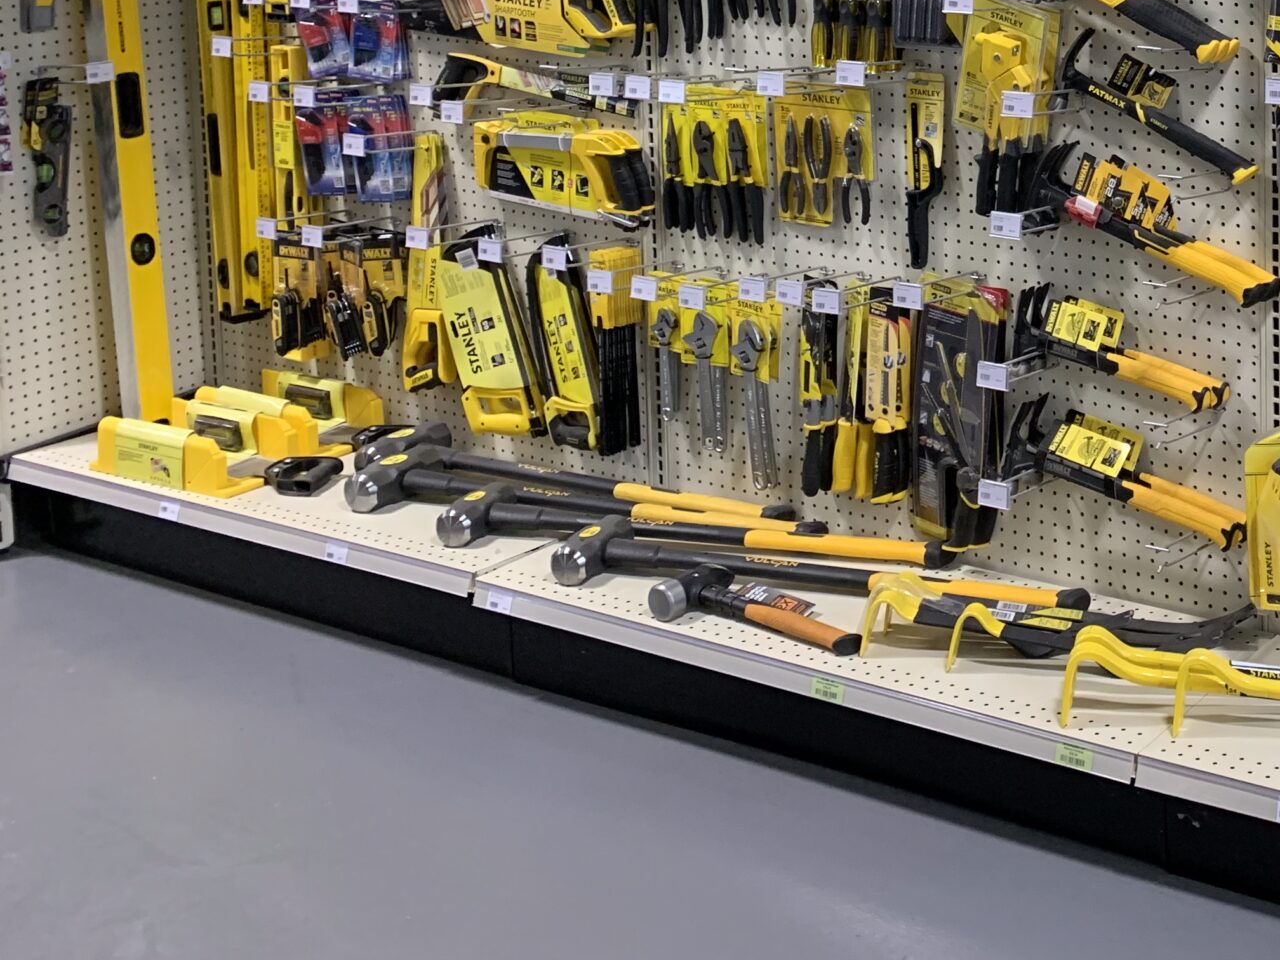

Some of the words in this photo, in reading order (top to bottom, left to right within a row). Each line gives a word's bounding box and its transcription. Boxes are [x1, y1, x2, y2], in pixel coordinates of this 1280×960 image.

[990, 11, 1023, 28] STANLEY
[802, 94, 841, 104] STANLEY
[910, 89, 940, 97] STANLEY
[1087, 85, 1127, 109] FATMAX
[1075, 160, 1090, 190] DEWALT
[737, 300, 763, 312] STANLEY
[1045, 302, 1059, 332] DEWALT
[454, 310, 483, 374] STANLEY
[545, 319, 568, 384] STANLEY
[1049, 423, 1067, 451] DEWALT
[523, 486, 571, 497] VULCAN
[745, 555, 799, 568] VULCAN
[1265, 542, 1274, 587] STANLEY
